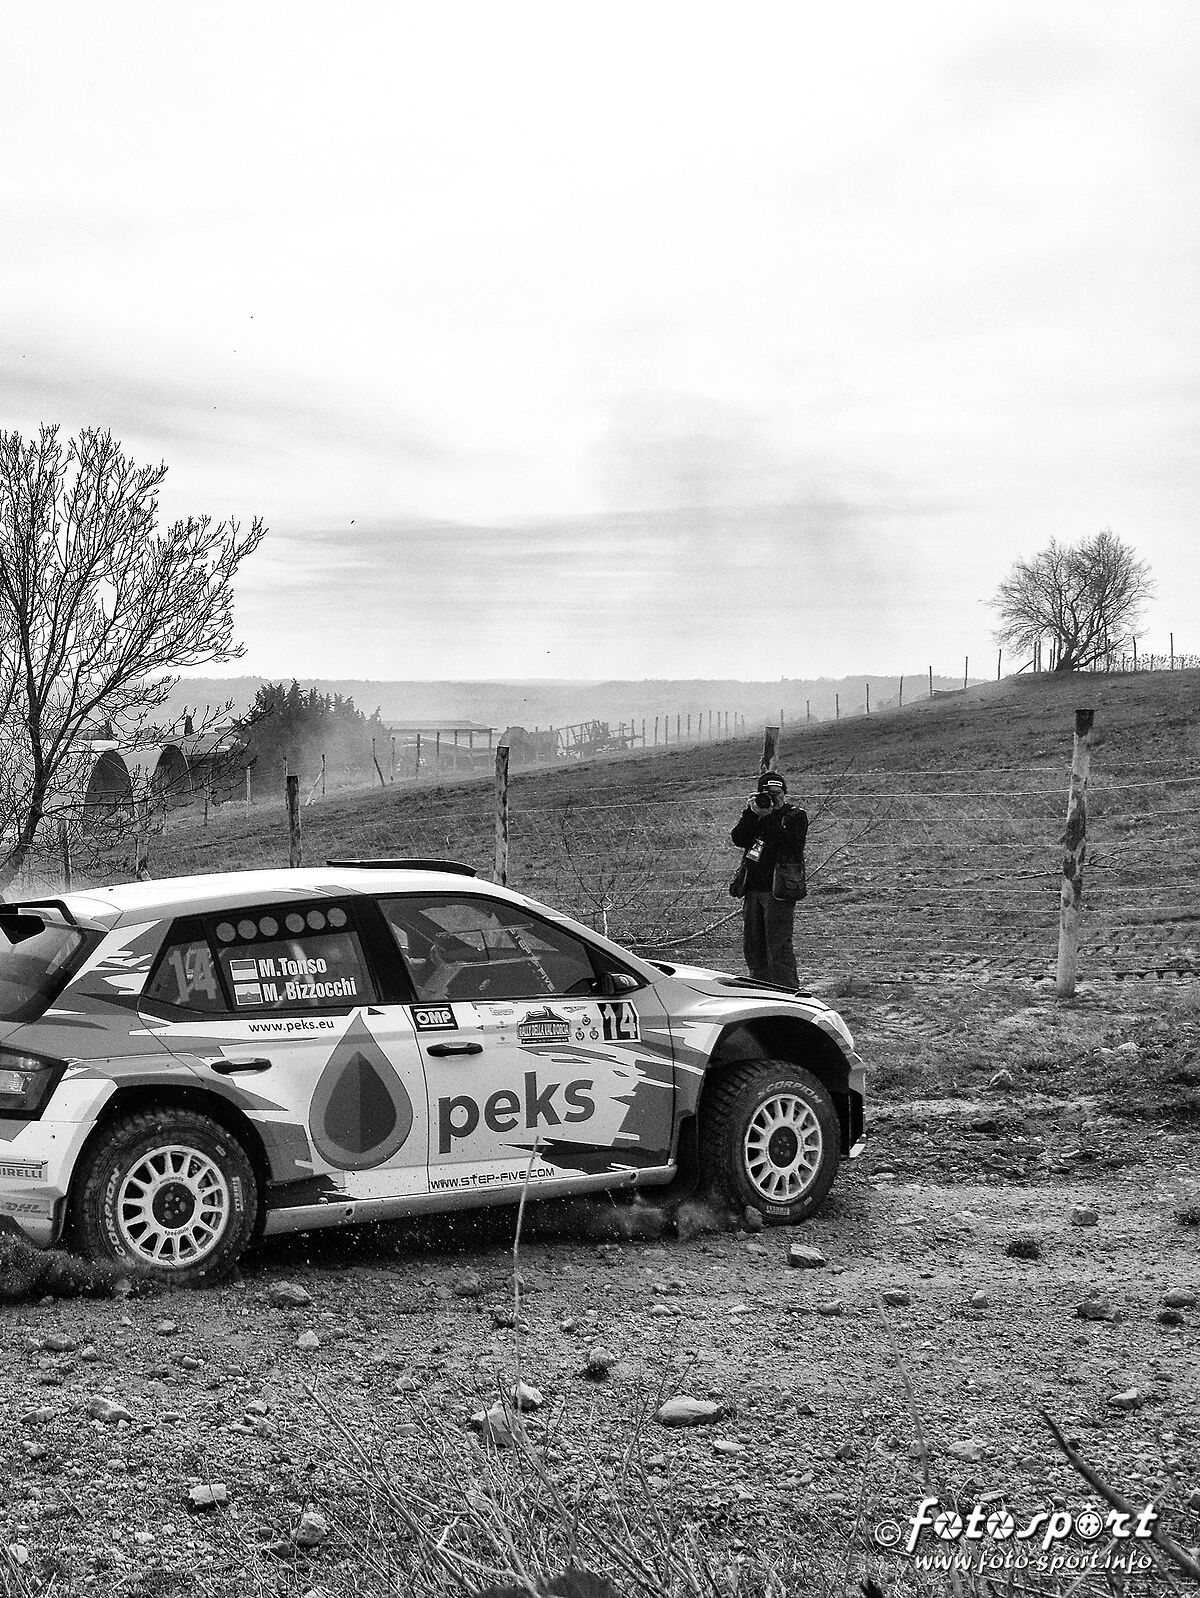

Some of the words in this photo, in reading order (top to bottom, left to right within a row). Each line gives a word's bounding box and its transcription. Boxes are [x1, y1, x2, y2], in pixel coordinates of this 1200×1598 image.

[168, 948, 217, 1003] 14
[258, 957, 327, 978] M.Tonso
[262, 983, 284, 1002] M.
[285, 977, 358, 1001] Bizzocchi
[248, 1019, 335, 1034] www.peks.eu
[416, 1010, 452, 1025] OMP
[603, 1003, 638, 1040] 14
[438, 1070, 596, 1154] peks
[430, 1167, 555, 1190] WWW.STEP-FIVECOM
